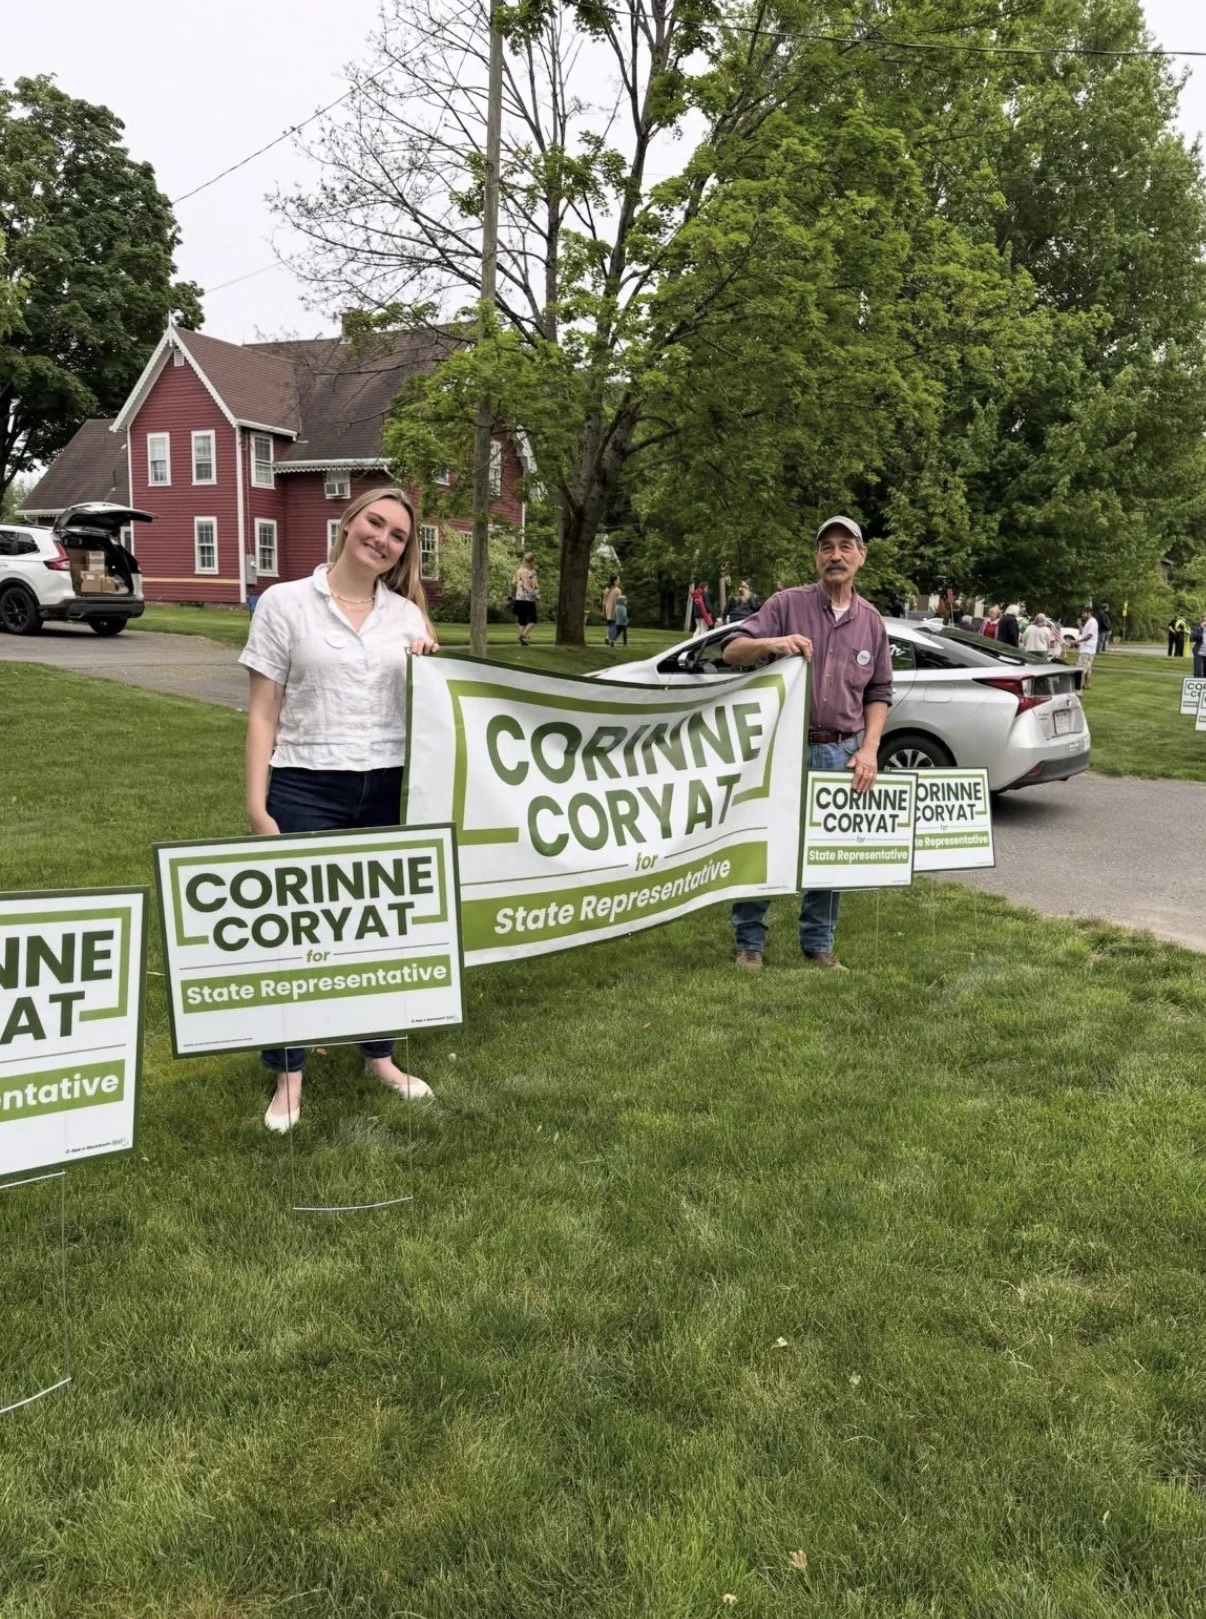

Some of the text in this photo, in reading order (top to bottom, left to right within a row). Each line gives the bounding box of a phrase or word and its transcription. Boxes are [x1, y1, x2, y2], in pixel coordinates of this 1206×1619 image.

[486, 702, 763, 786] CORINNE
[527, 773, 742, 857] CORYAT
[816, 787, 908, 811] CORINNE
[823, 812, 899, 833] CORYAT
[925, 834, 989, 849] Representative
[634, 852, 659, 871] for
[809, 848, 908, 864] State Representative
[185, 856, 434, 913] CORINNE
[494, 859, 731, 935] State Representative
[213, 901, 415, 952] CORYAT
[306, 949, 331, 963] for
[186, 963, 448, 1006] State Representative
[0, 990, 86, 1046] AT
[2, 1073, 120, 1111] ntative
